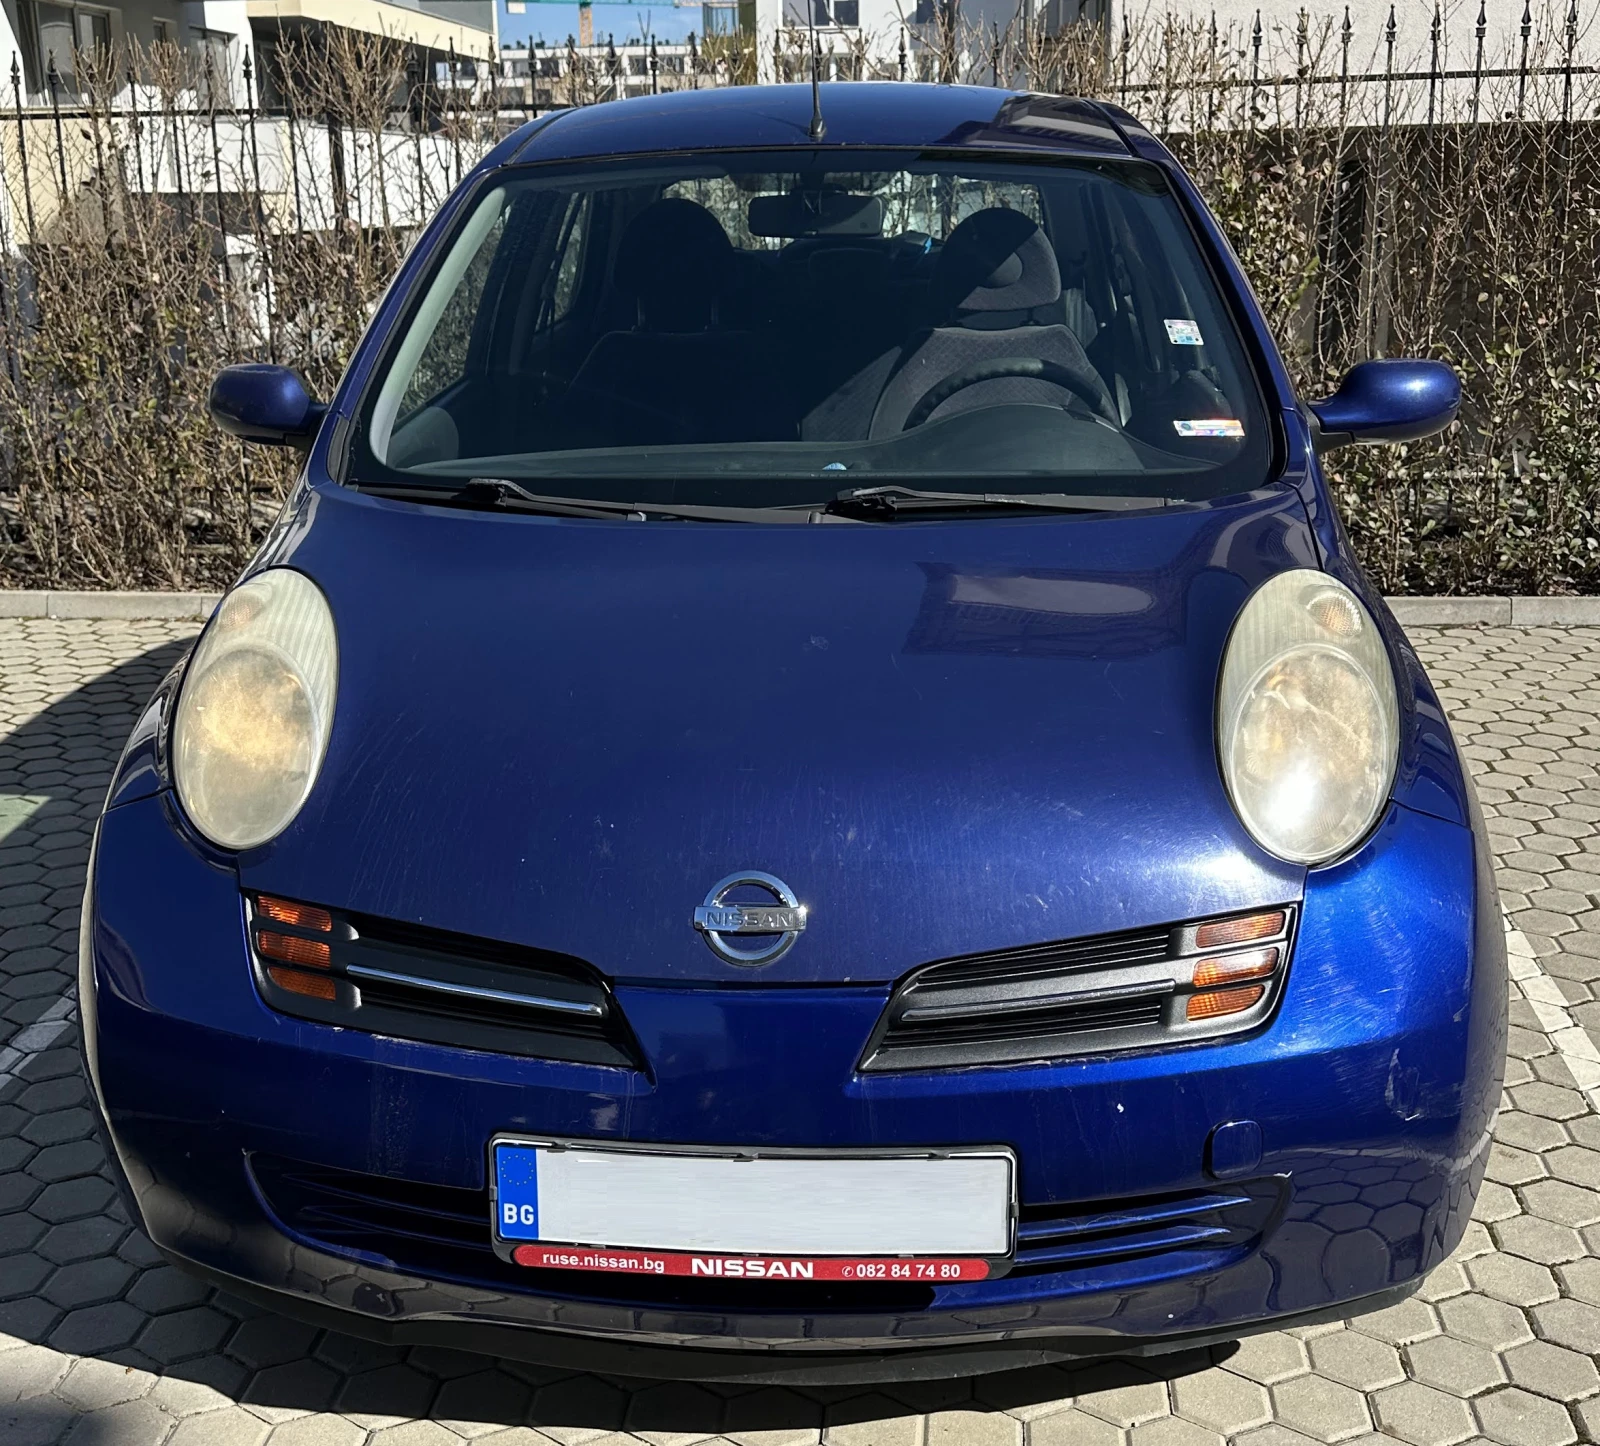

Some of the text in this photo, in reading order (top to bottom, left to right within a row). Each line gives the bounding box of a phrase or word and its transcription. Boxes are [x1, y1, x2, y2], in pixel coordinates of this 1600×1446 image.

[705, 912, 794, 928] NISSAN
[503, 1202, 535, 1226] BG
[542, 1253, 961, 1278] ruse.nissan.bg NISSAN 082 84 74 80
